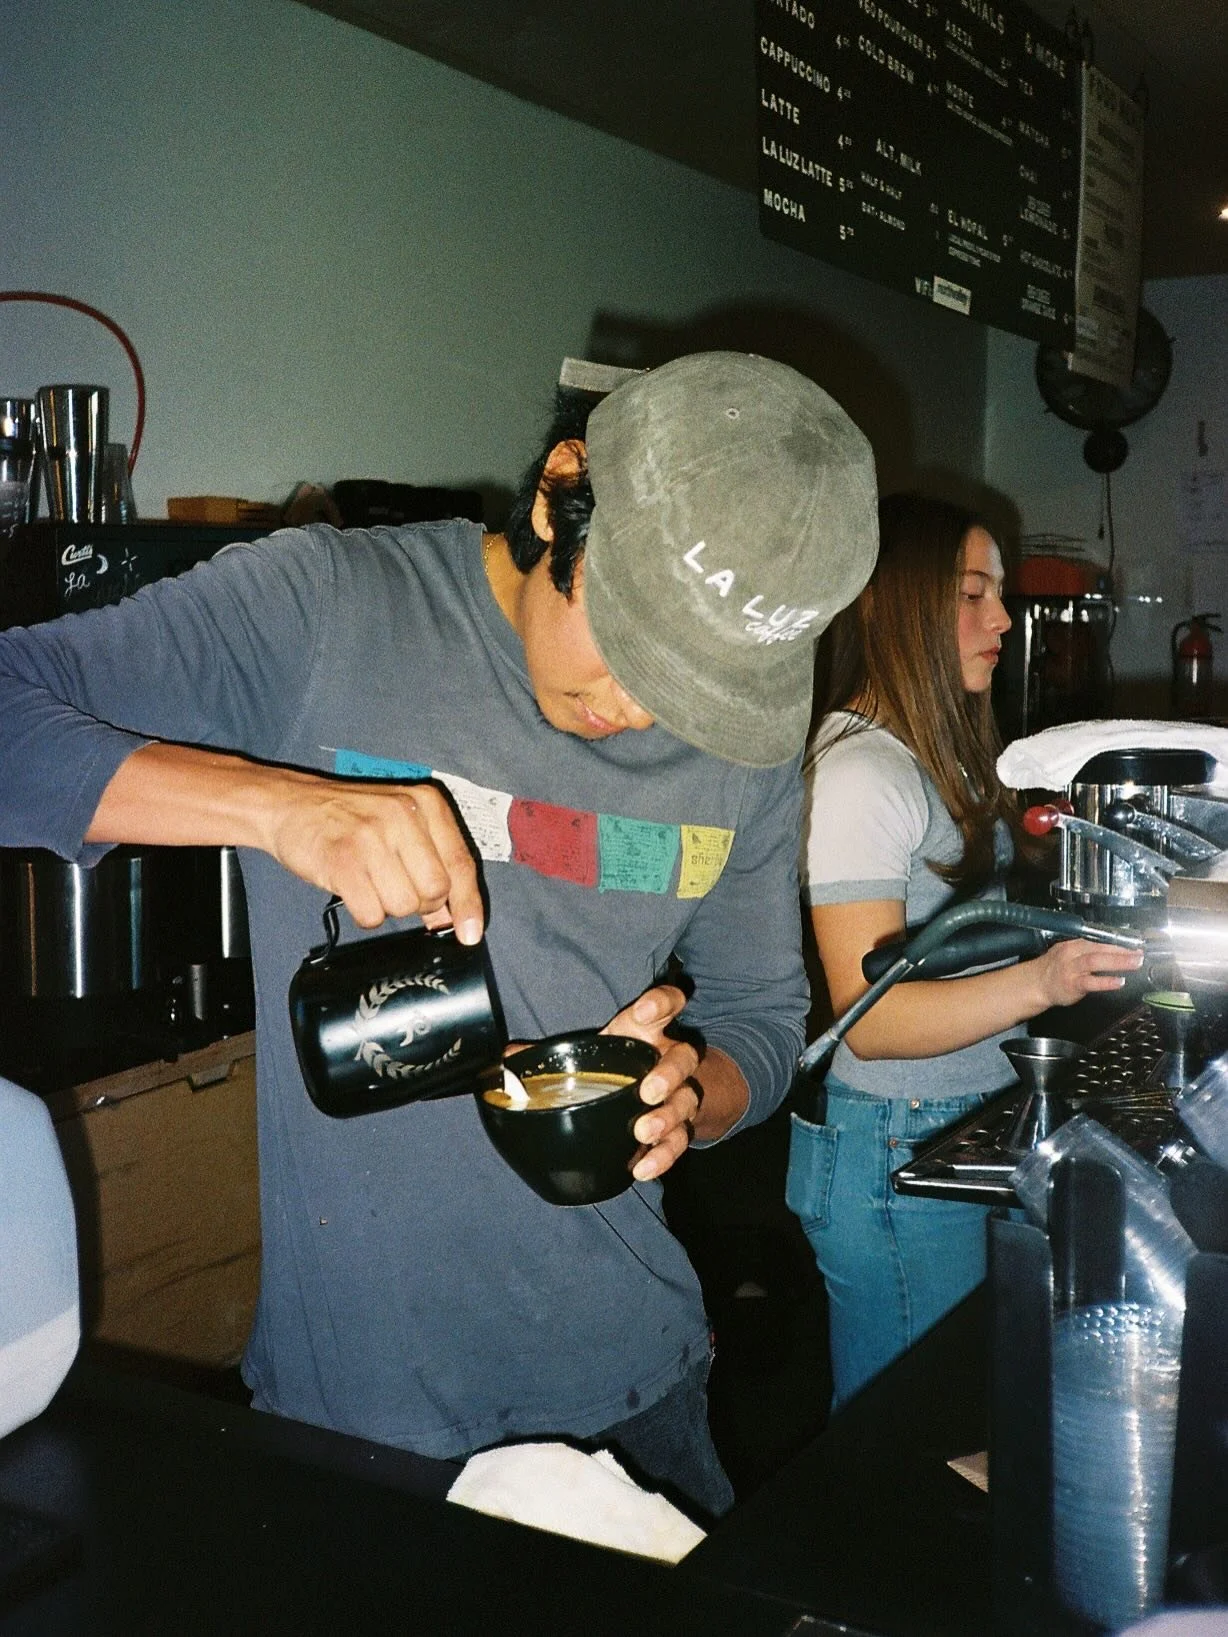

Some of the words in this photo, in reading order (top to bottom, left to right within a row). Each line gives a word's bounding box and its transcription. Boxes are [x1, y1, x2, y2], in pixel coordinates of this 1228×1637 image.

[760, 36, 830, 93] CAPPUCCINO
[859, 35, 885, 64] COLD
[887, 54, 914, 84] BREW
[761, 88, 800, 124] LATTE
[762, 136, 777, 159] LA
[779, 145, 799, 171] LUZ
[801, 156, 832, 187] LATTE
[763, 188, 806, 222] MOCHA
[683, 540, 735, 597] LA
[742, 595, 819, 628] LUZ
